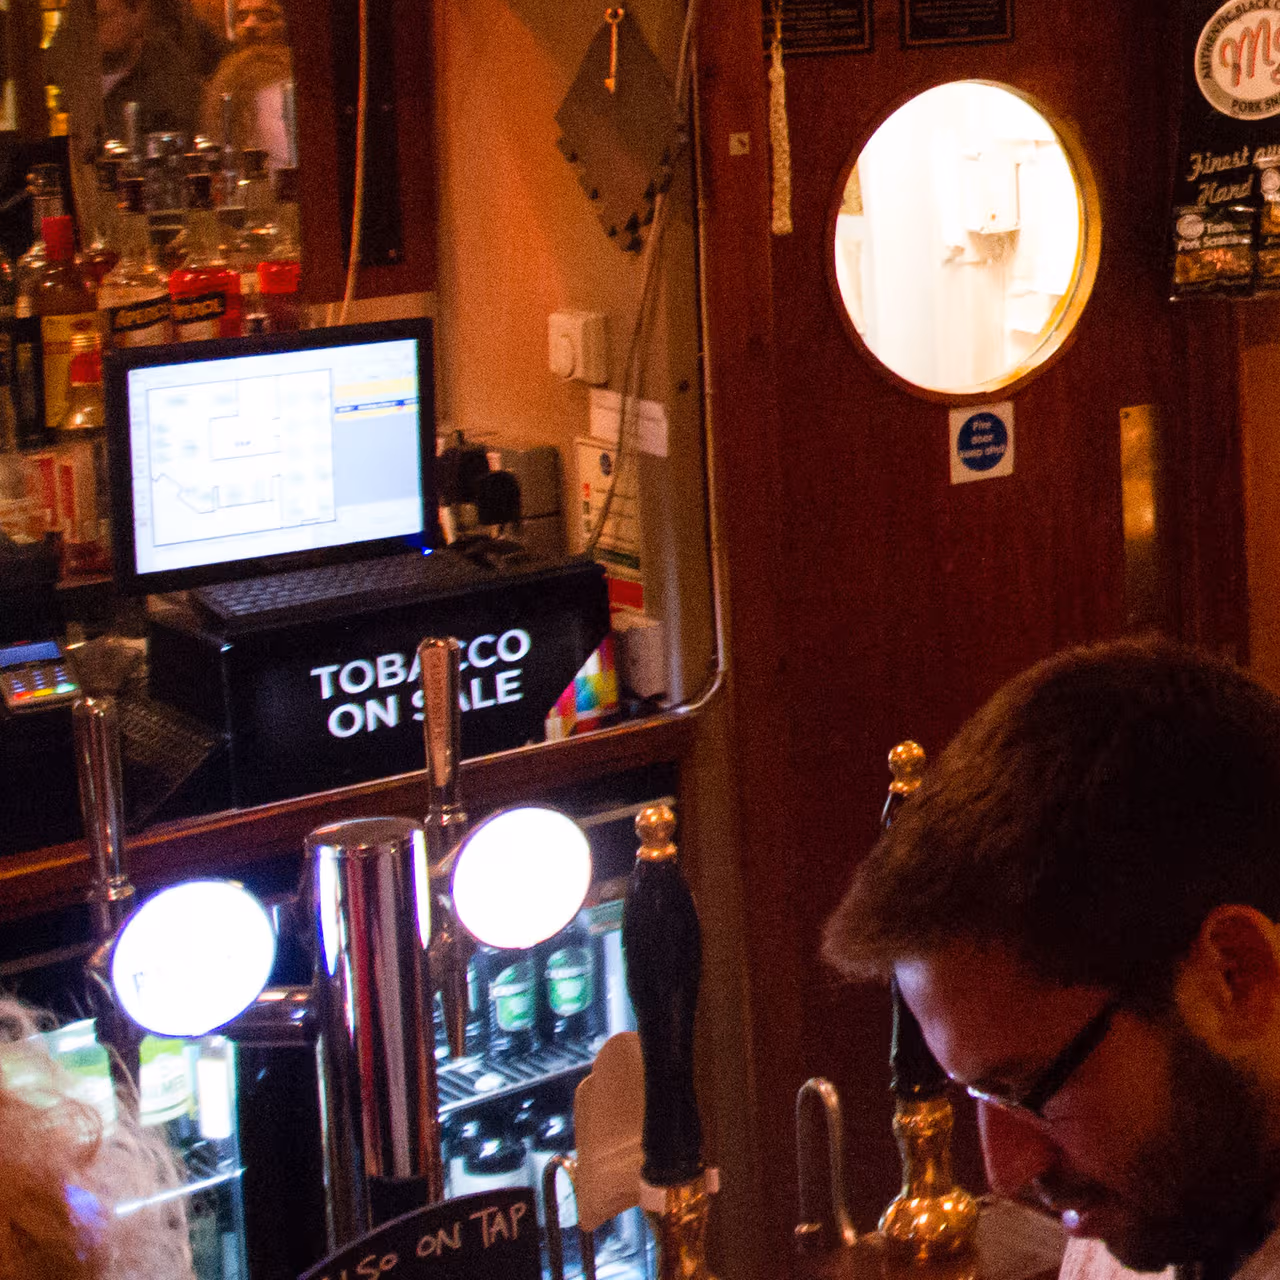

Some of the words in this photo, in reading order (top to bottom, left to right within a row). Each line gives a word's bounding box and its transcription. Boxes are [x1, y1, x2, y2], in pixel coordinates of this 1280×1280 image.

[1234, 0, 1270, 16] BLACK
[1230, 98, 1262, 114] PORK
[327, 694, 400, 739] ON
[415, 1222, 462, 1258] ON
[468, 1201, 528, 1250] TAP
